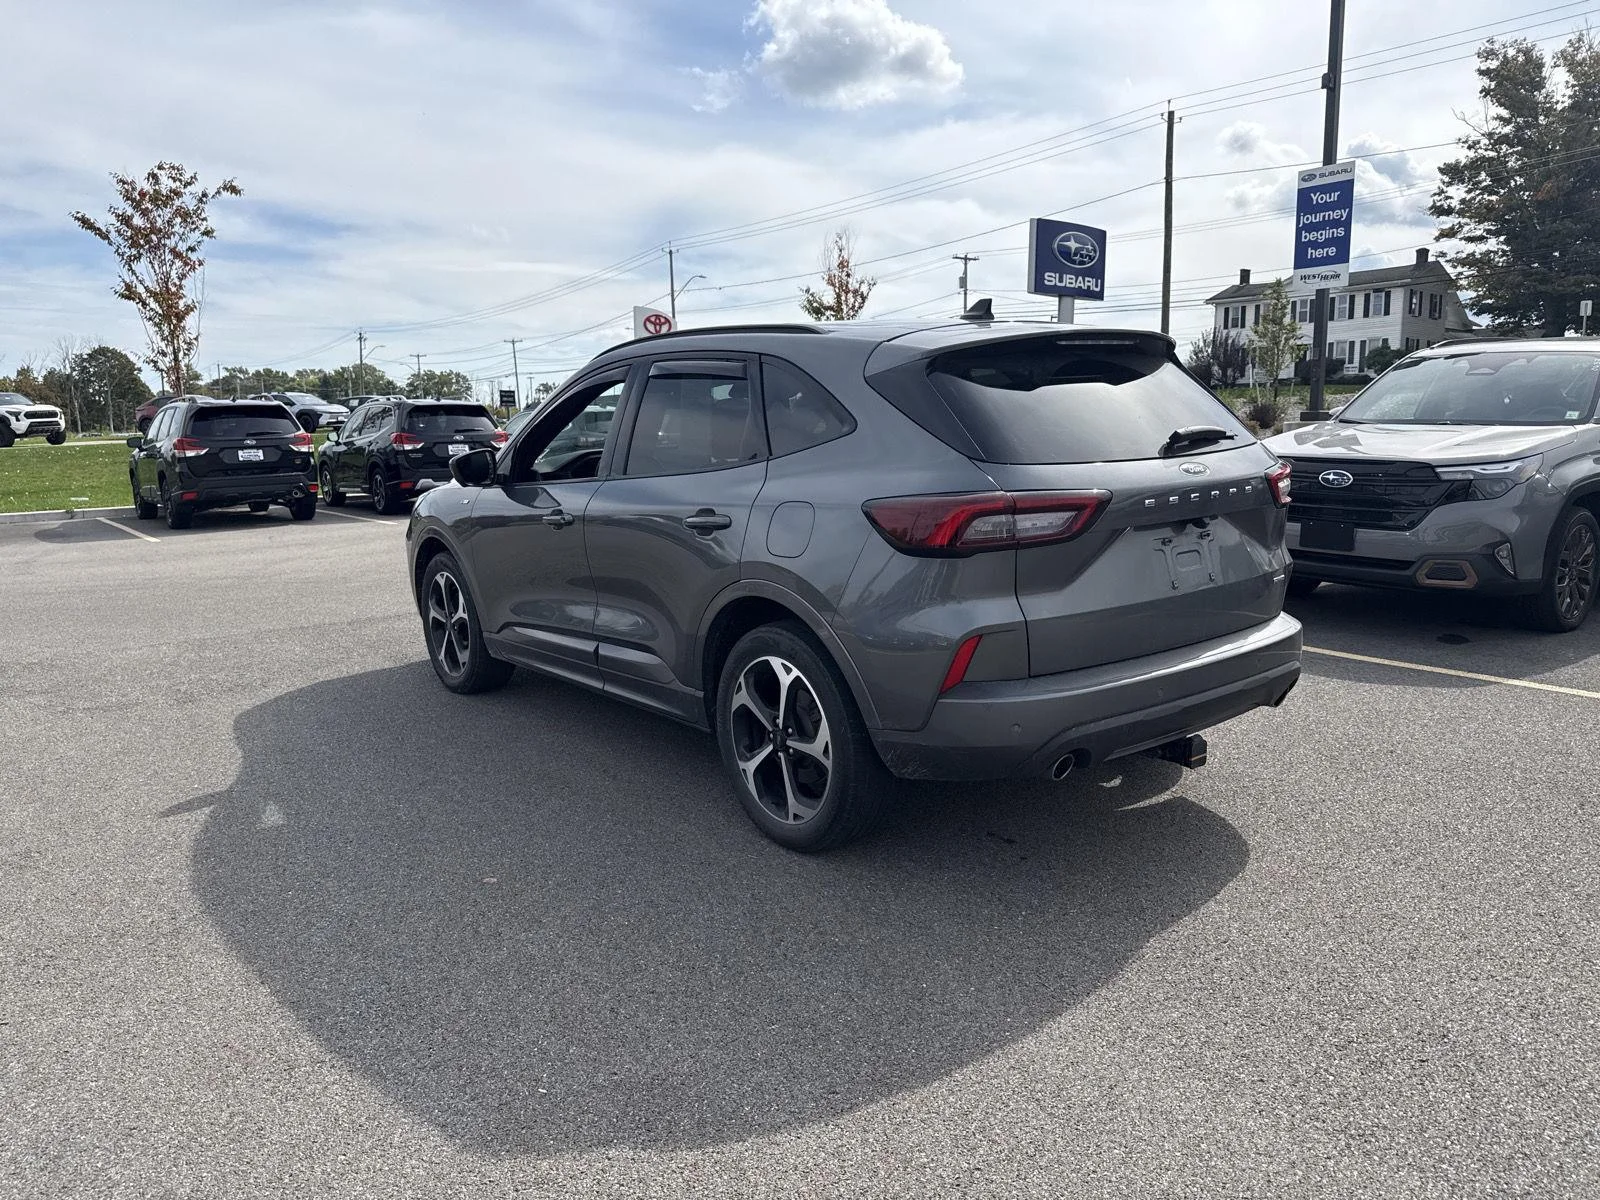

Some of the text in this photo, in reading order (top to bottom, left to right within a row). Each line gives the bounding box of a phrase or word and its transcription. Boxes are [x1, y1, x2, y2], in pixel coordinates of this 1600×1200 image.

[1318, 168, 1353, 178] SUBARU
[1310, 191, 1341, 205] Your
[1299, 208, 1350, 228] journey
[1301, 226, 1345, 243] begins
[1307, 246, 1337, 259] here
[1043, 271, 1101, 292] SUBARU
[1144, 485, 1253, 508] ESCAPE
